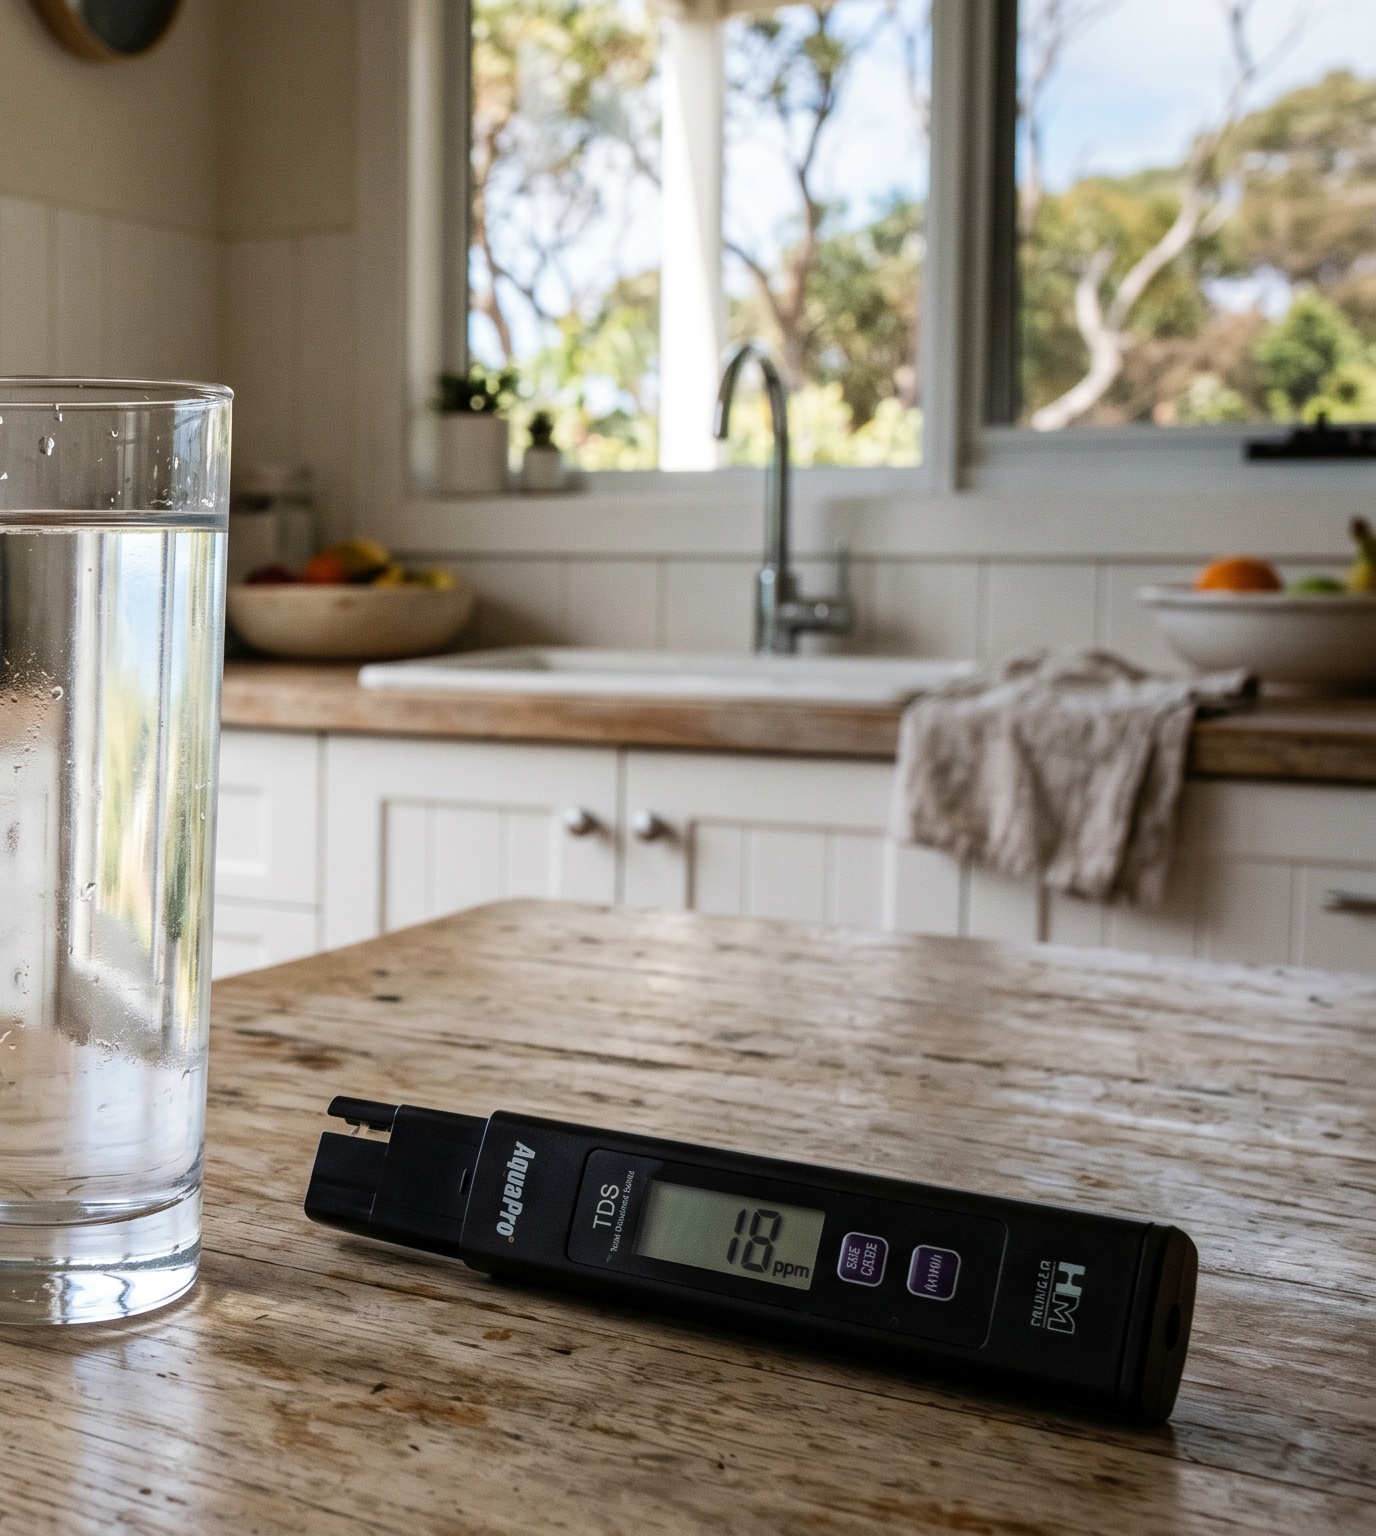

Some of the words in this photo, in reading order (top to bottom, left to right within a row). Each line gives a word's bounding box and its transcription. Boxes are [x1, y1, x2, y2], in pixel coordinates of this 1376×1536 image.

[592, 1184, 620, 1229] TDS
[726, 1208, 782, 1273] 18
[773, 1260, 810, 1278] ppm
[1047, 1261, 1086, 1334] HM
